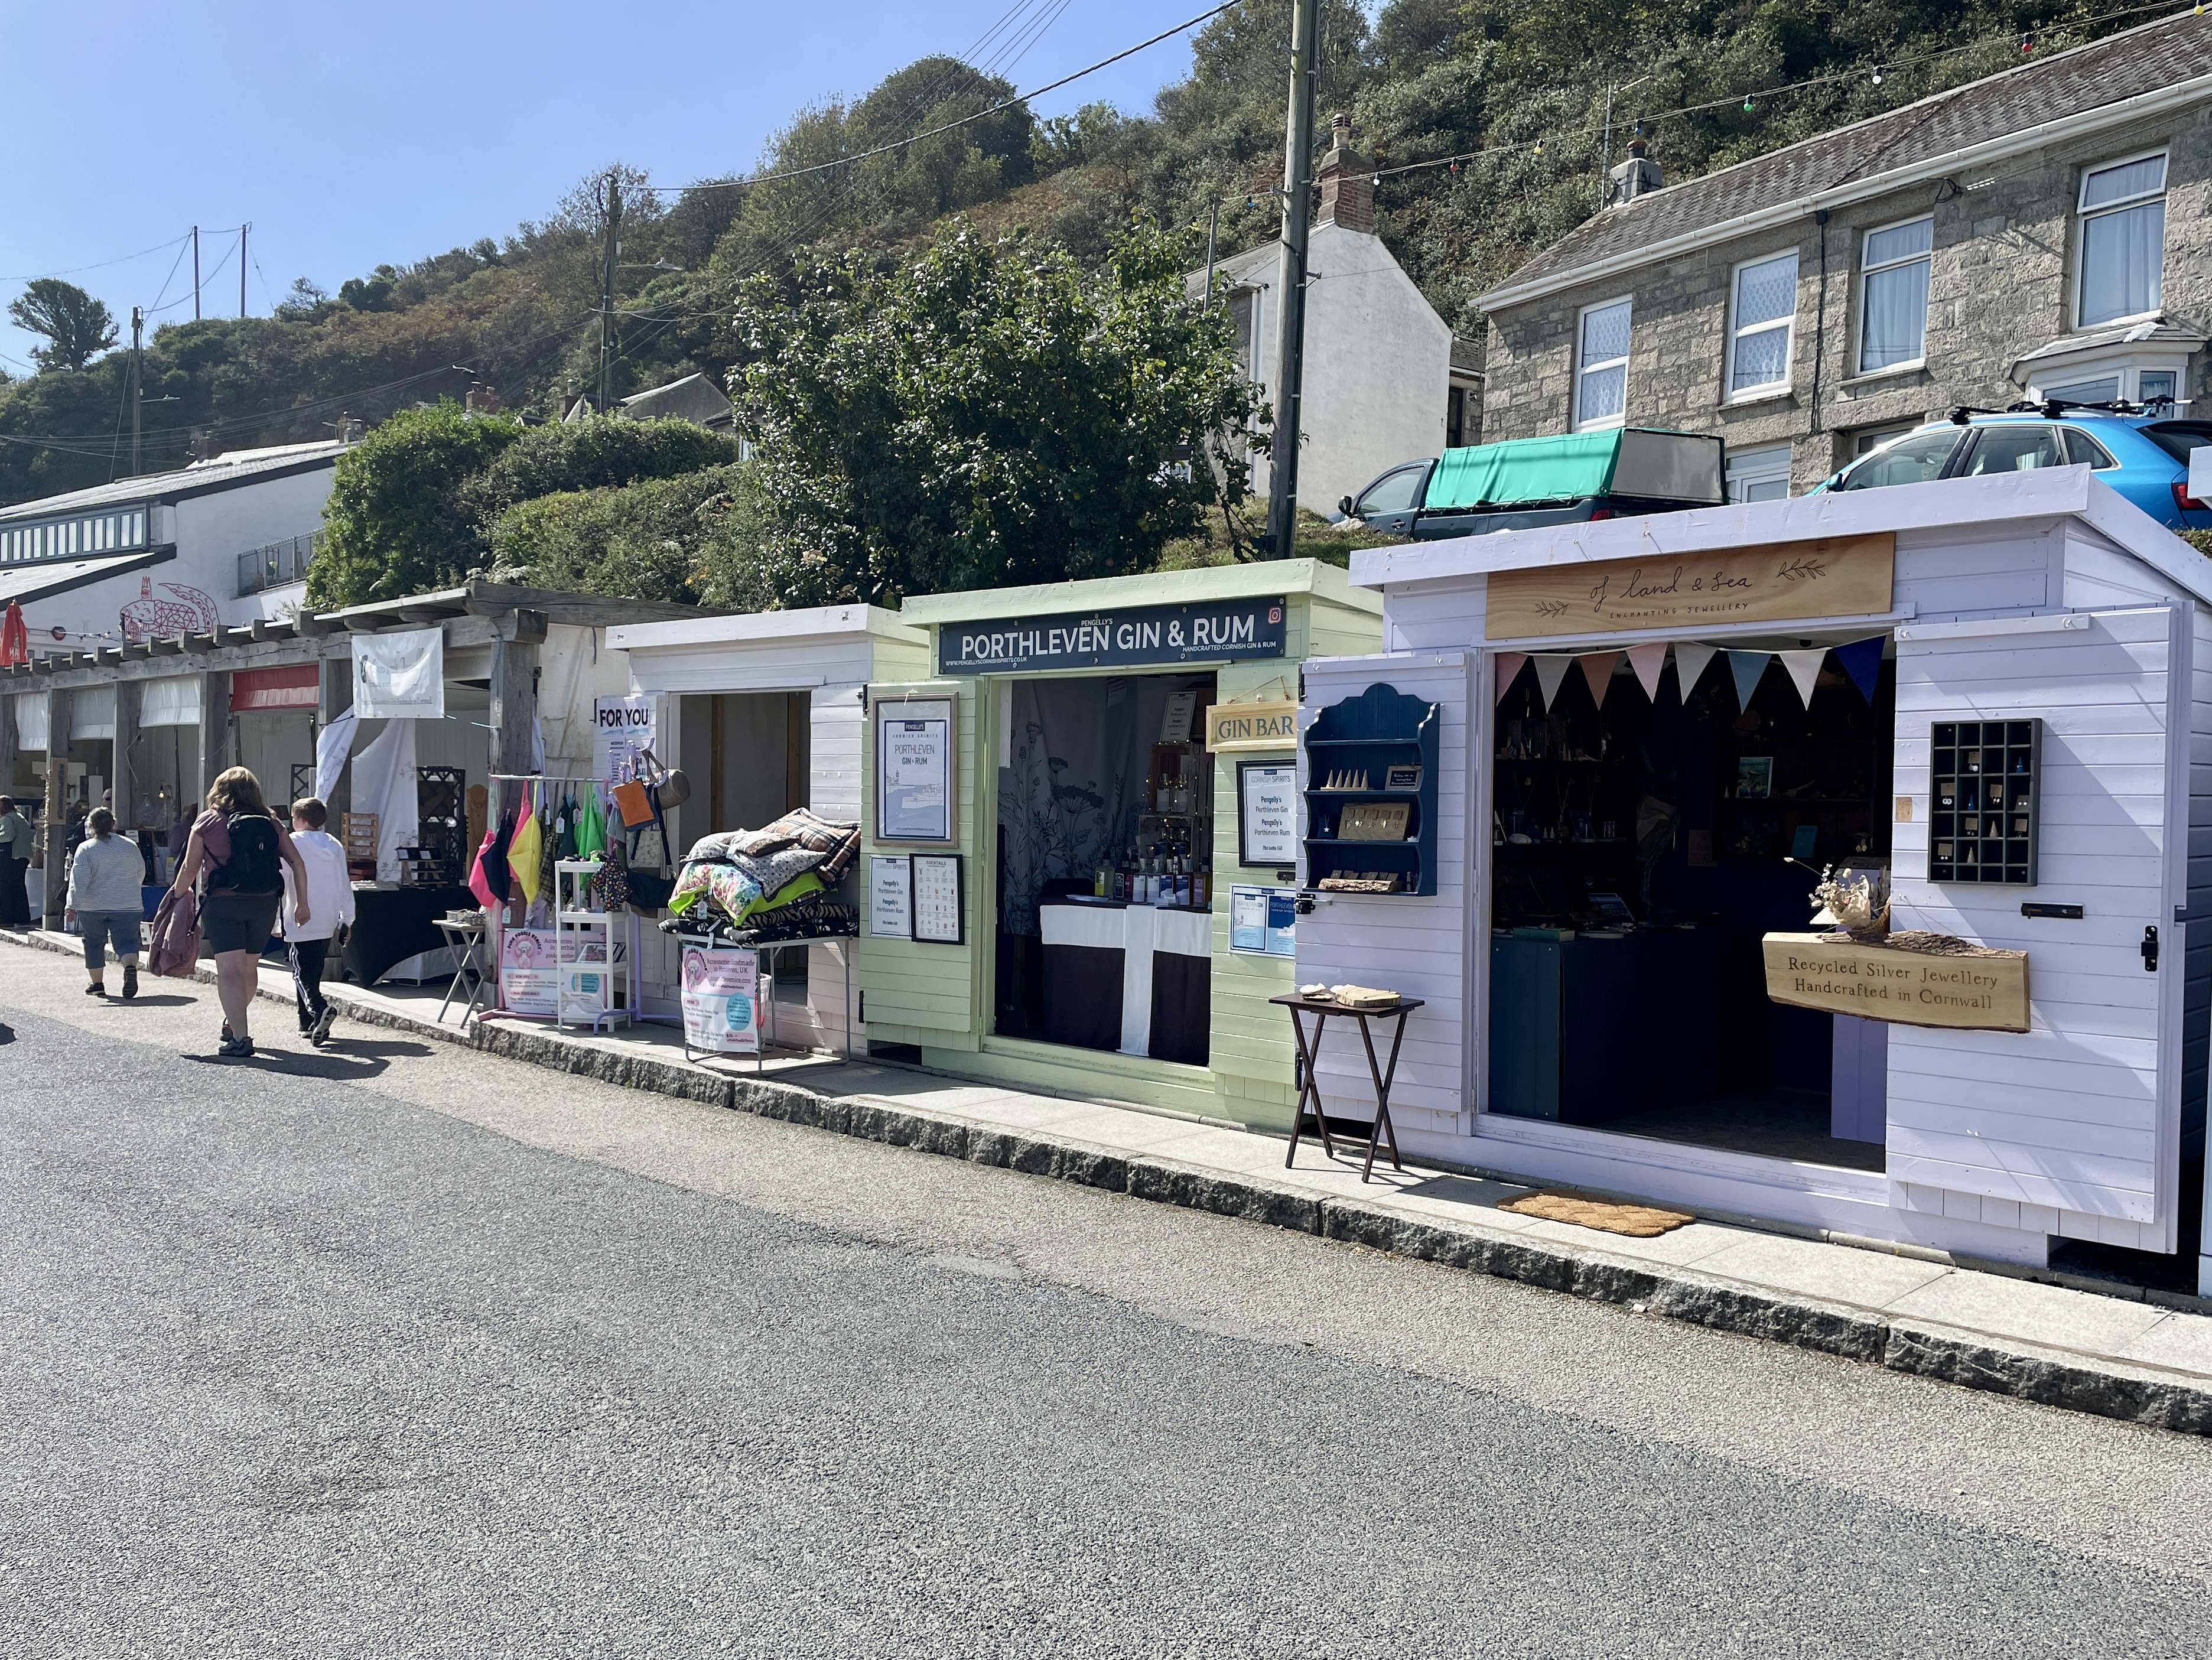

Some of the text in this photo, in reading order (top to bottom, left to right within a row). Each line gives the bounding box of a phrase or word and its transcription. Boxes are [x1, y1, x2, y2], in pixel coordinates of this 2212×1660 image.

[1590, 575, 1609, 613] of
[1619, 566, 1683, 598] land
[1691, 578, 1703, 591] &
[1610, 603, 1749, 619] ENCHANTING JEWELLERY
[1081, 618, 1113, 626] PENGELLY'S
[961, 614, 1255, 659] PORTHLEVEN GIN & RUM
[599, 708, 649, 727] FOR YOU
[1218, 715, 1294, 738] GIN BAR
[894, 744, 935, 754] PORTHLEVEN
[902, 757, 912, 765] GIN
[1261, 796, 1282, 805] Pengelly's
[1261, 819, 1282, 827] Pengelly's
[1788, 956, 1998, 989] Recycled Silver Jewellery
[1794, 978, 1992, 1009] Handcrafted in Cornwall
